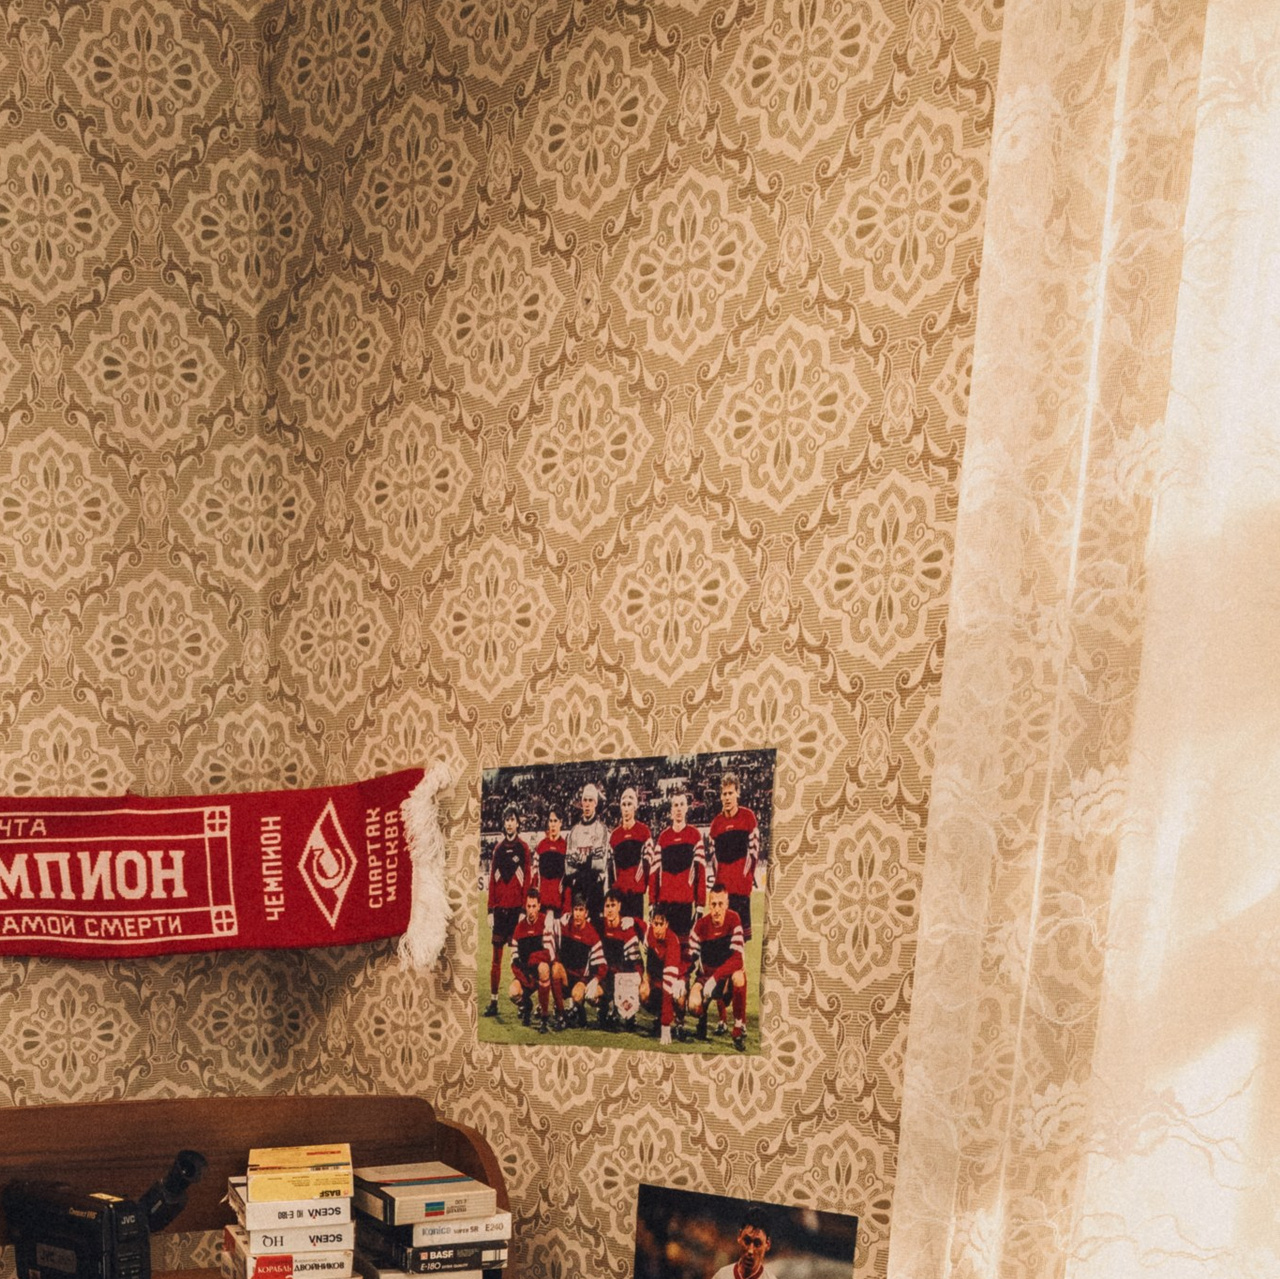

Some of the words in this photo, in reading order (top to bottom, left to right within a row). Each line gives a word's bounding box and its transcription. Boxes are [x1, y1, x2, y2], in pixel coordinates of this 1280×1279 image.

[366, 807, 383, 909] СПАРТАК
[385, 810, 399, 902] МОСКВА
[260, 816, 285, 921] ЧЕМПИОН
[85, 918, 182, 938] СМЕРТИ
[319, 1189, 341, 1198] BASF
[121, 1215, 135, 1224] JVC
[278, 1210, 294, 1219] E-180
[422, 1225, 451, 1236] Konica
[485, 1223, 504, 1231] E240
[262, 1235, 284, 1248] HQ
[430, 1250, 454, 1259] BASF
[257, 1266, 291, 1274] КОРАБЛЬ
[294, 1262, 345, 1272] ДВОЙНИКОВ
[420, 1262, 441, 1271] E-180
